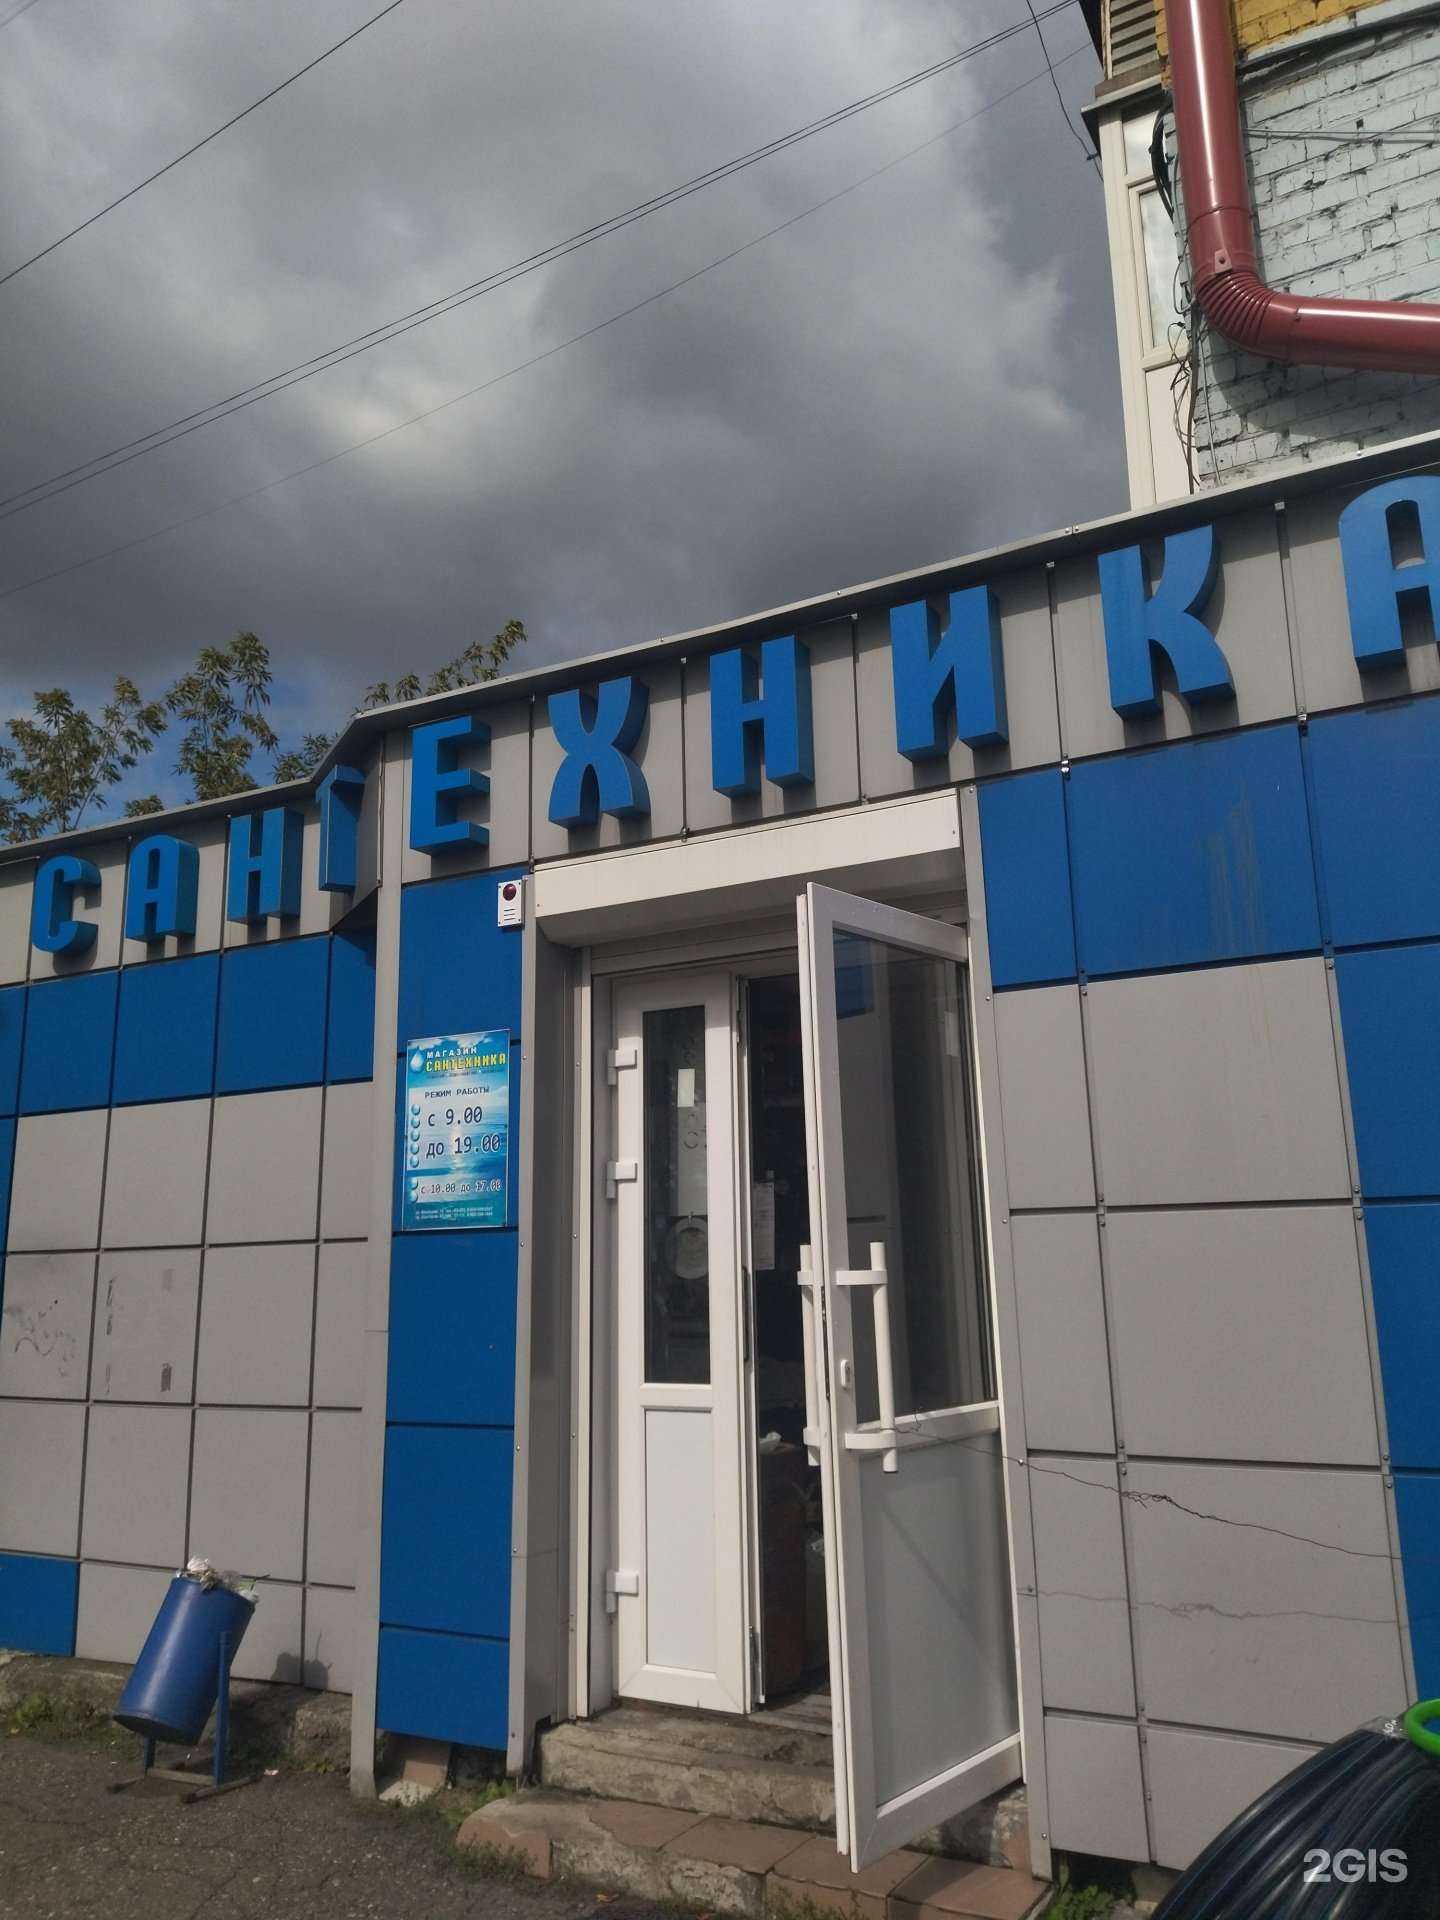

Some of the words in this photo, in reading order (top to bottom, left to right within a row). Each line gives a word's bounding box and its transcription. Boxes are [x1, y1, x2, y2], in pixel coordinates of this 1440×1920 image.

[426, 1047, 477, 1059] МАГАЗИН
[425, 1090, 452, 1098] РЕЖИМ
[456, 1086, 490, 1096] РАБОТЫ
[445, 1106, 483, 1126] 9.00
[454, 1133, 501, 1154] 19.00
